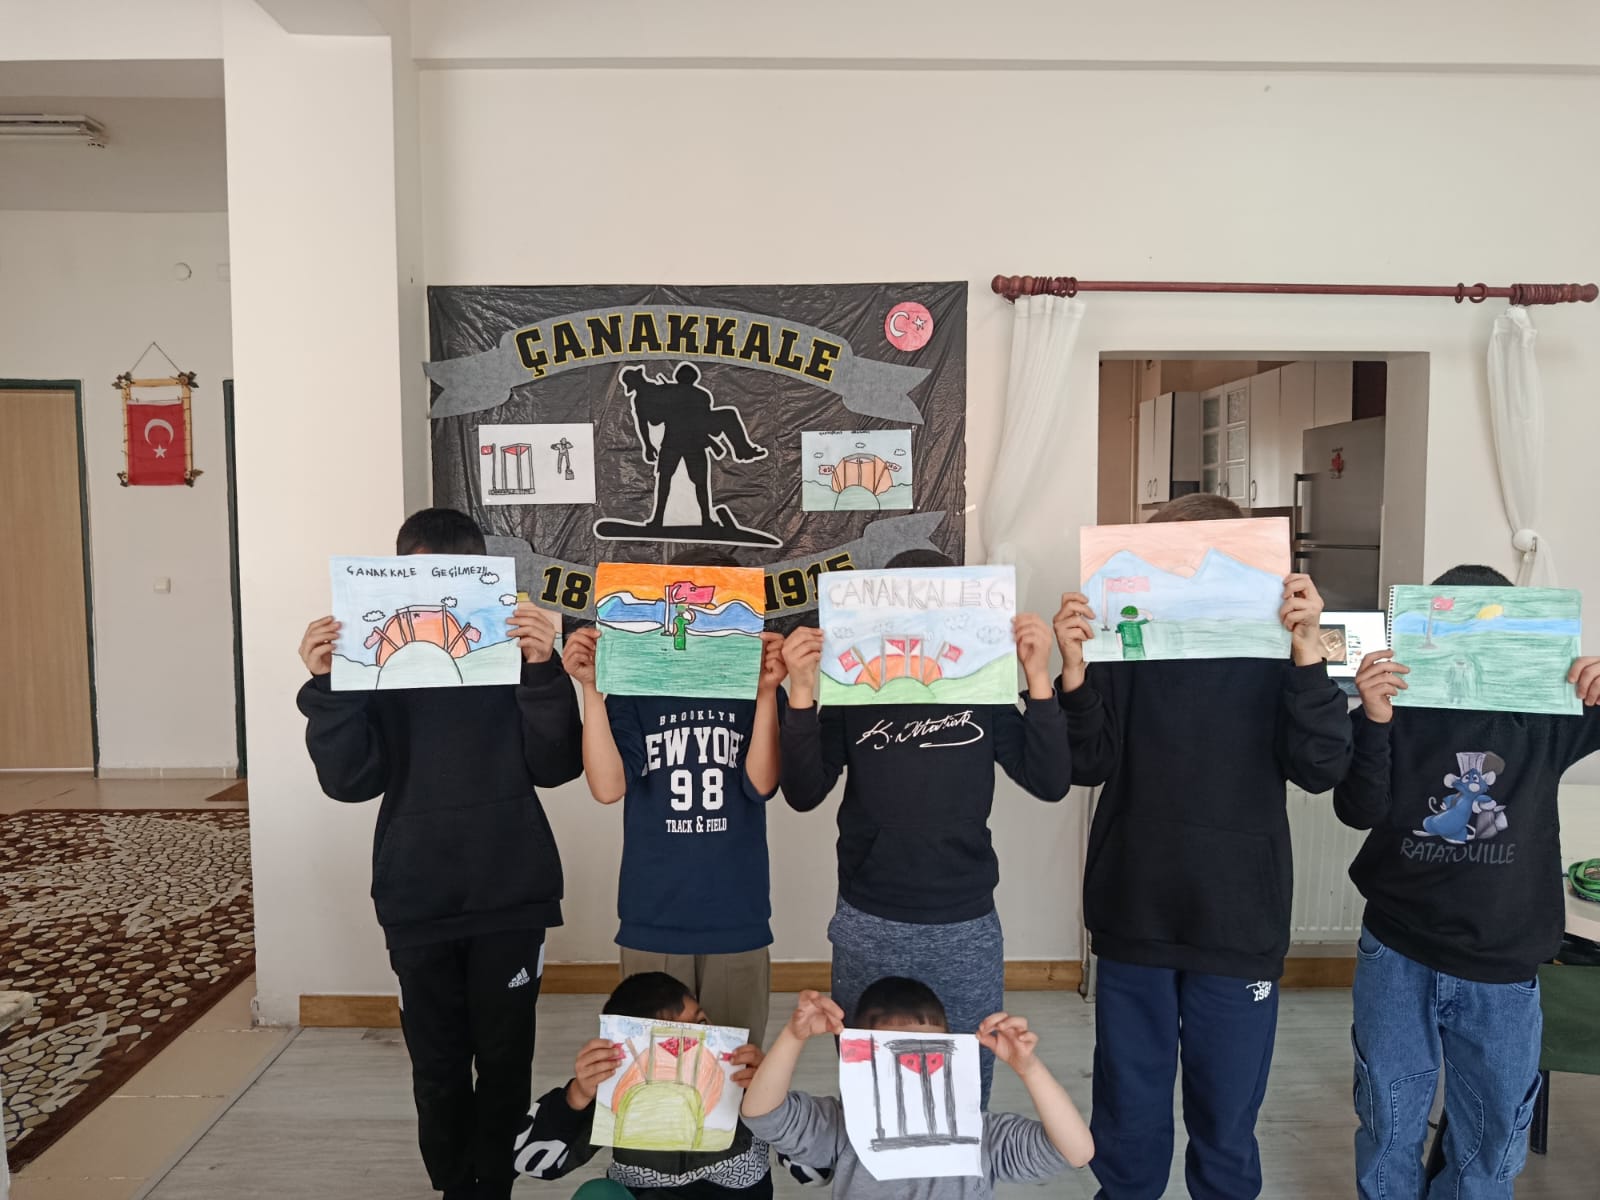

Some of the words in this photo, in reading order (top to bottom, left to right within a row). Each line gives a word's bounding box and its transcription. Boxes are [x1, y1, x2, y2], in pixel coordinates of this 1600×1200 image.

[515, 312, 843, 383] ÇANAKKALE
[541, 565, 593, 611] 18
[659, 709, 736, 726] BROOKLYN
[641, 726, 691, 777] EW
[693, 726, 744, 769] YOR
[670, 768, 724, 811] 98
[665, 819, 693, 833] TRACK
[696, 815, 704, 833] &
[706, 817, 727, 832] FIELD
[1400, 838, 1516, 864] RATATOUILLE
